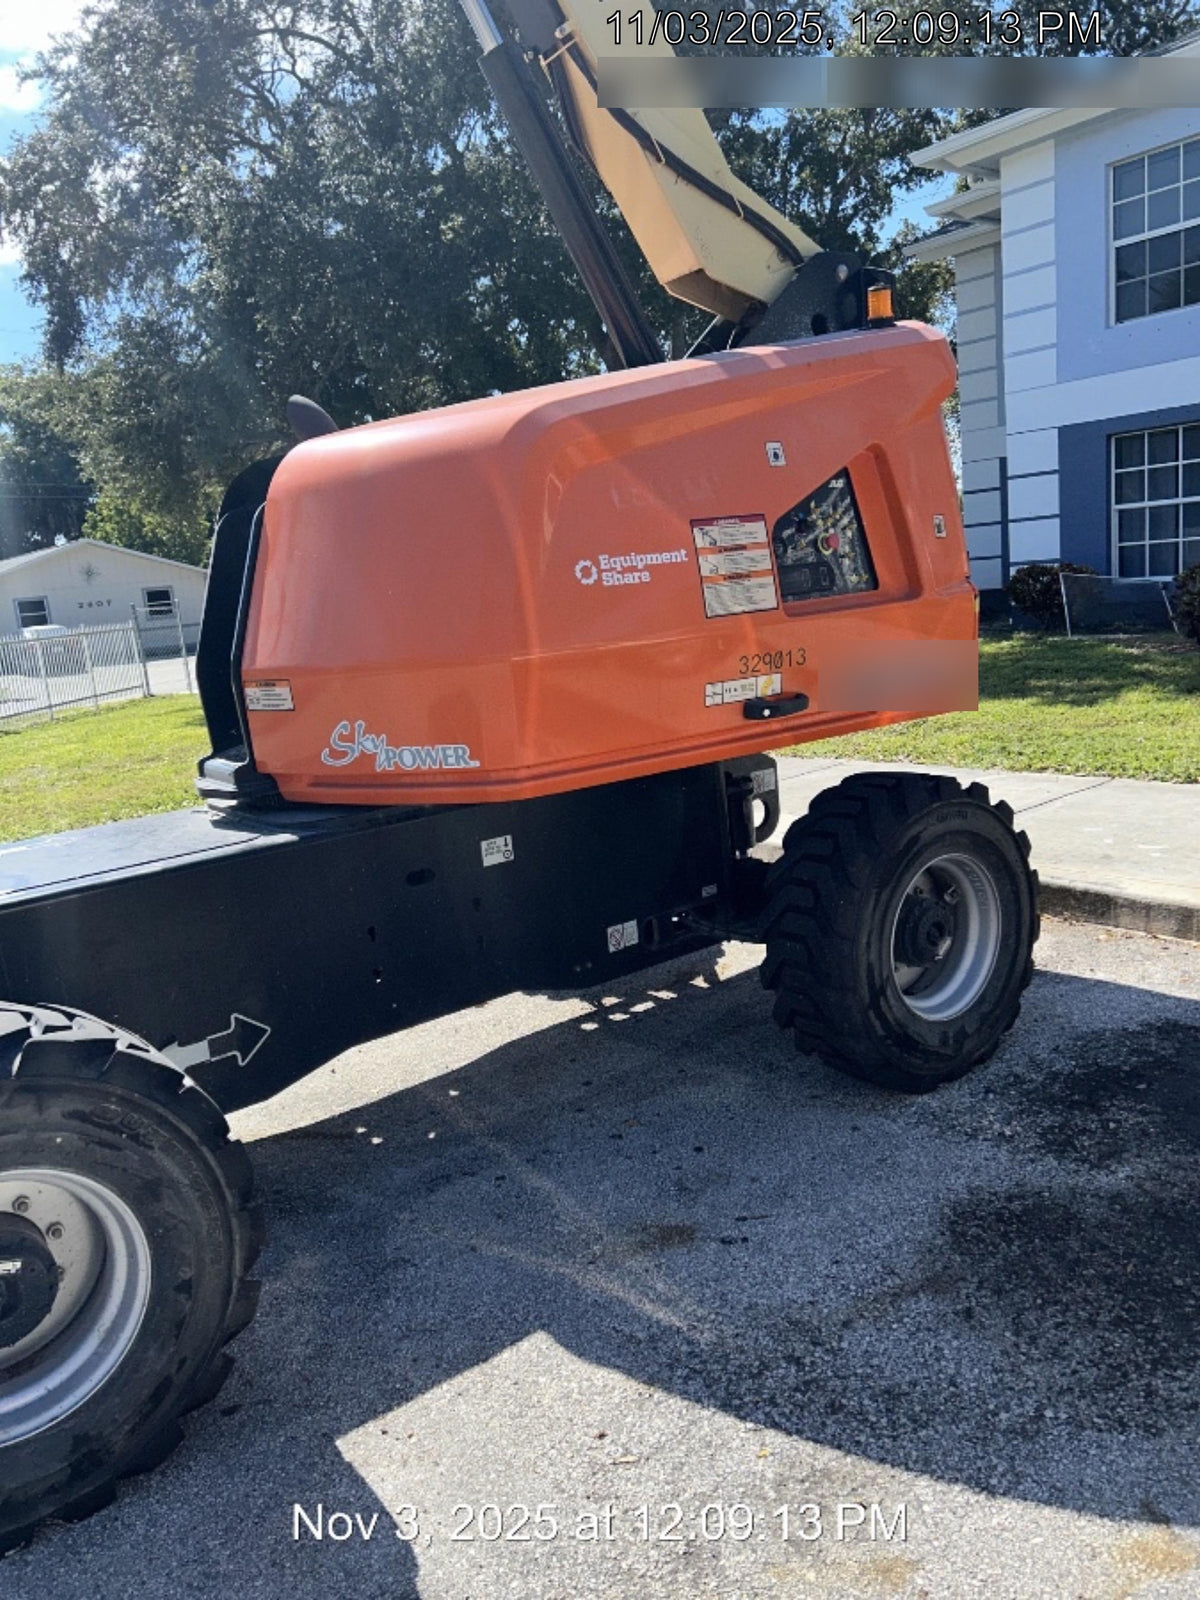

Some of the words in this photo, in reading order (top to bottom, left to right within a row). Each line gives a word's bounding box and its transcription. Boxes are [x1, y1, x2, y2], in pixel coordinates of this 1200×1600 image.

[598, 549, 689, 571] Equipment
[601, 571, 651, 586] Share
[739, 648, 806, 674] 329013
